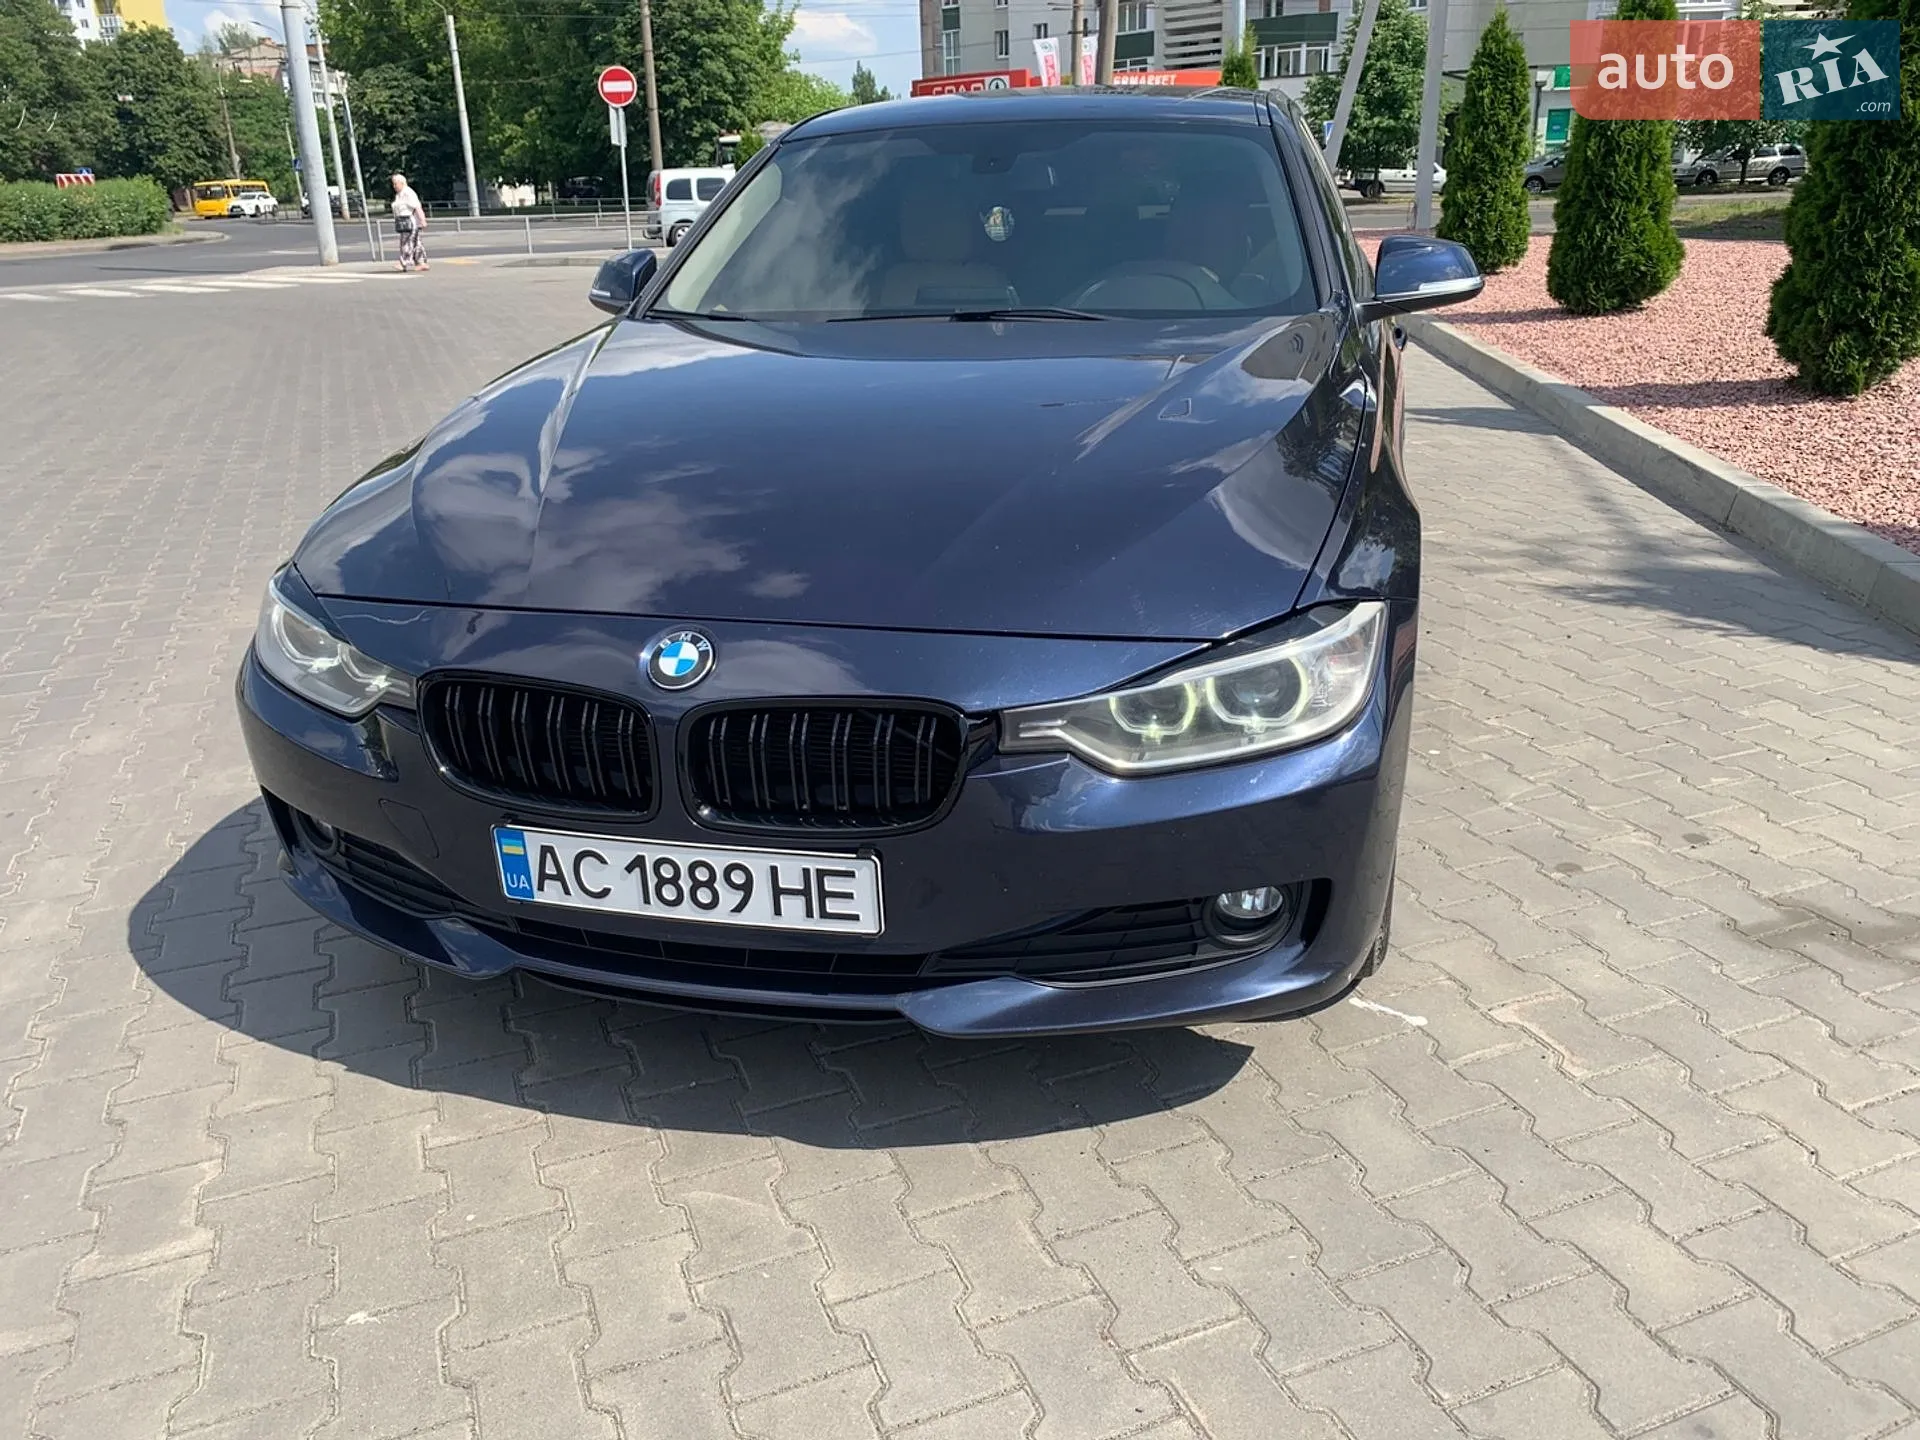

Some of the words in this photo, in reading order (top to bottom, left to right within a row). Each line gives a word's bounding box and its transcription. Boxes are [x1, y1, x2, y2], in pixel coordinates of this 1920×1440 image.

[659, 630, 710, 651] BMW
[506, 871, 531, 890] UA
[536, 844, 613, 900] AC
[624, 854, 755, 914] 1889
[769, 865, 861, 921] HE
